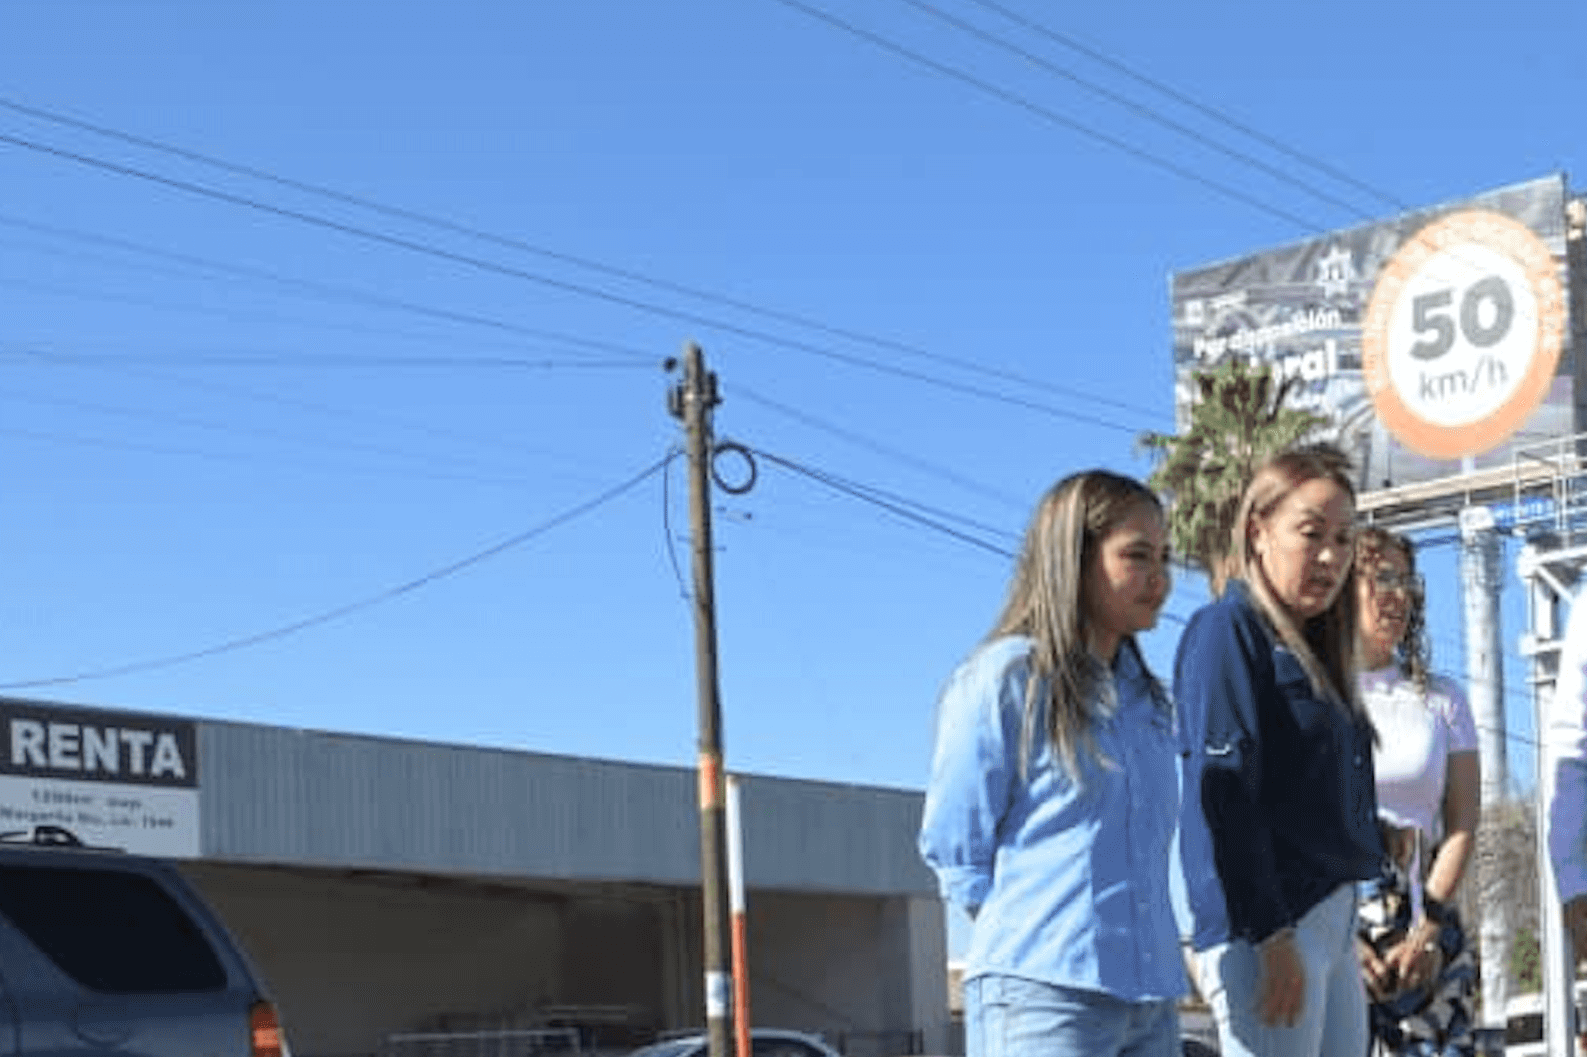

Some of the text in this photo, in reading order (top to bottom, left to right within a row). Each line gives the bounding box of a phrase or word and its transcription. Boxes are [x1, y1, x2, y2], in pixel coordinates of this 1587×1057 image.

[1408, 274, 1515, 361] 50
[1419, 354, 1510, 400] km/h
[10, 718, 186, 779] RENTA
